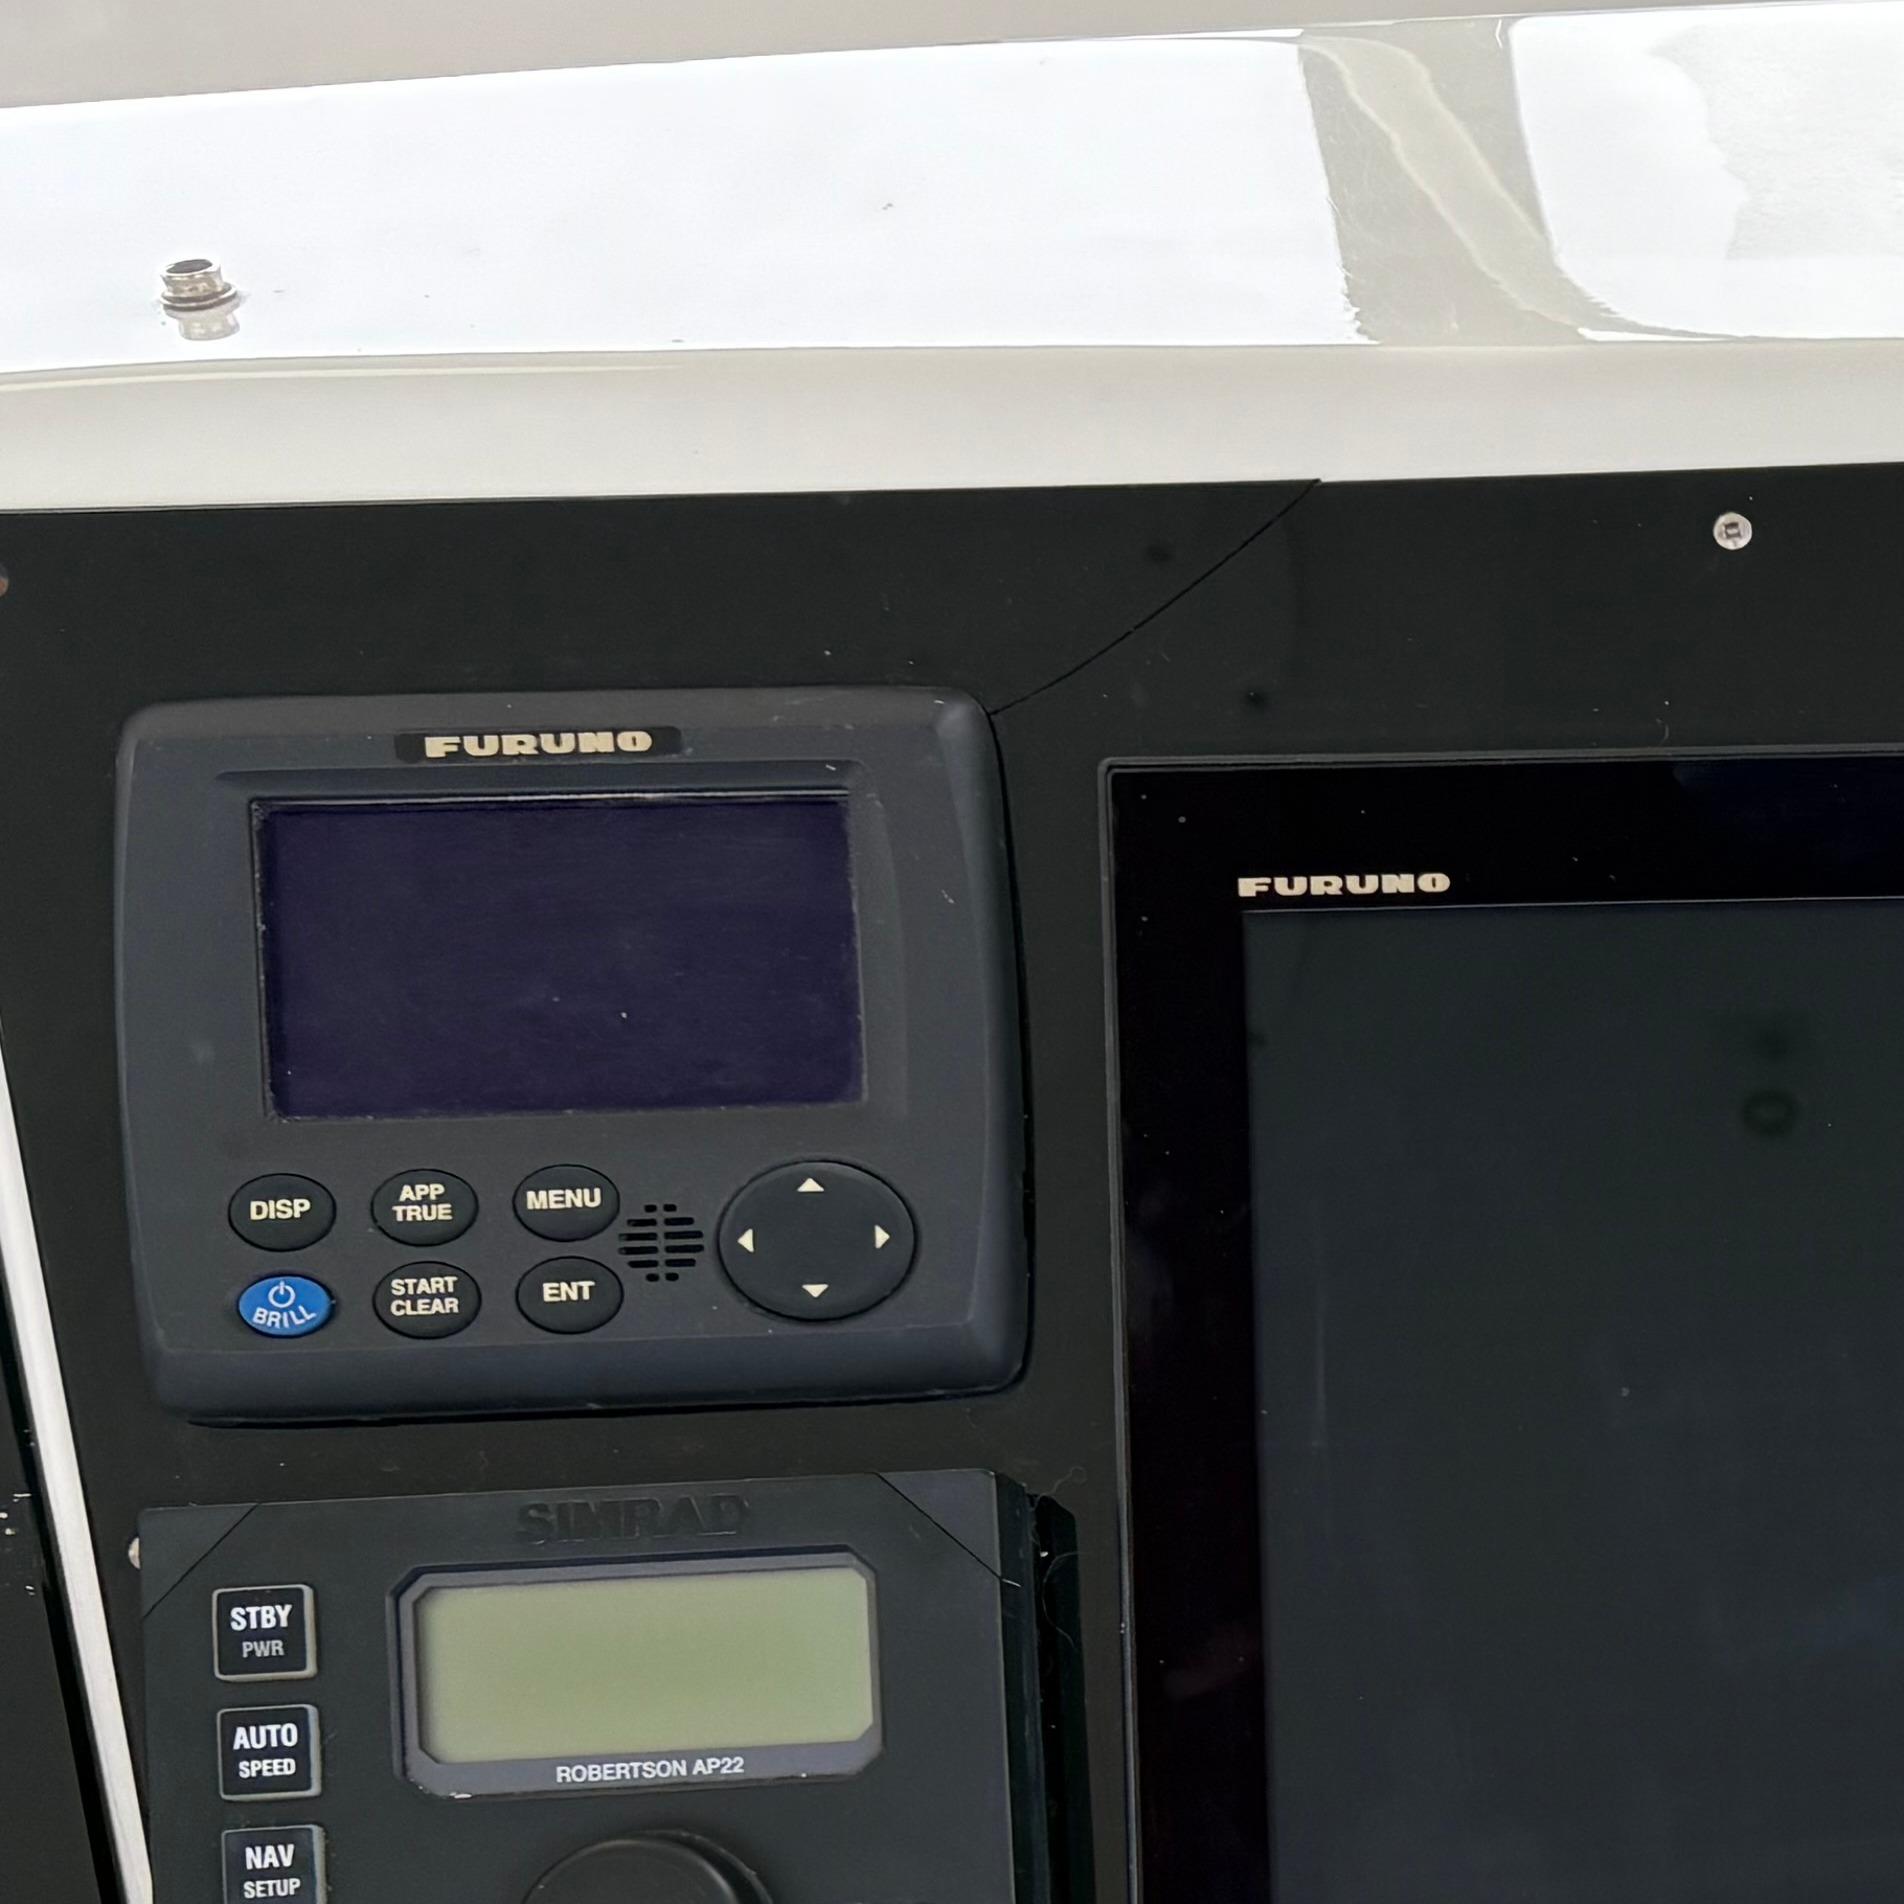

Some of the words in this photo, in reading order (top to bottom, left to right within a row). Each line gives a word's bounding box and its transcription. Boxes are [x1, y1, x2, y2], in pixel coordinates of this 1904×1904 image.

[424, 730, 653, 758] FURUNO
[1237, 872, 1451, 897] FURUNO
[399, 1183, 446, 1202] APP
[525, 1187, 602, 1211] MENU
[249, 1198, 311, 1221] DISP
[391, 1203, 454, 1223] TRUE
[390, 1276, 458, 1296] START
[542, 1280, 596, 1303] ENT
[252, 1306, 318, 1329] BRILL
[390, 1298, 460, 1317] CLEAR
[229, 1604, 292, 1632] STBY
[241, 1639, 285, 1659] PWR
[232, 1722, 299, 1750] AUTO
[238, 1757, 297, 1779] SPEED
[556, 1759, 688, 1784] ROBERTSON
[692, 1756, 746, 1777] AP22
[244, 1843, 295, 1871] NAV
[243, 1877, 301, 1899] SETUP
